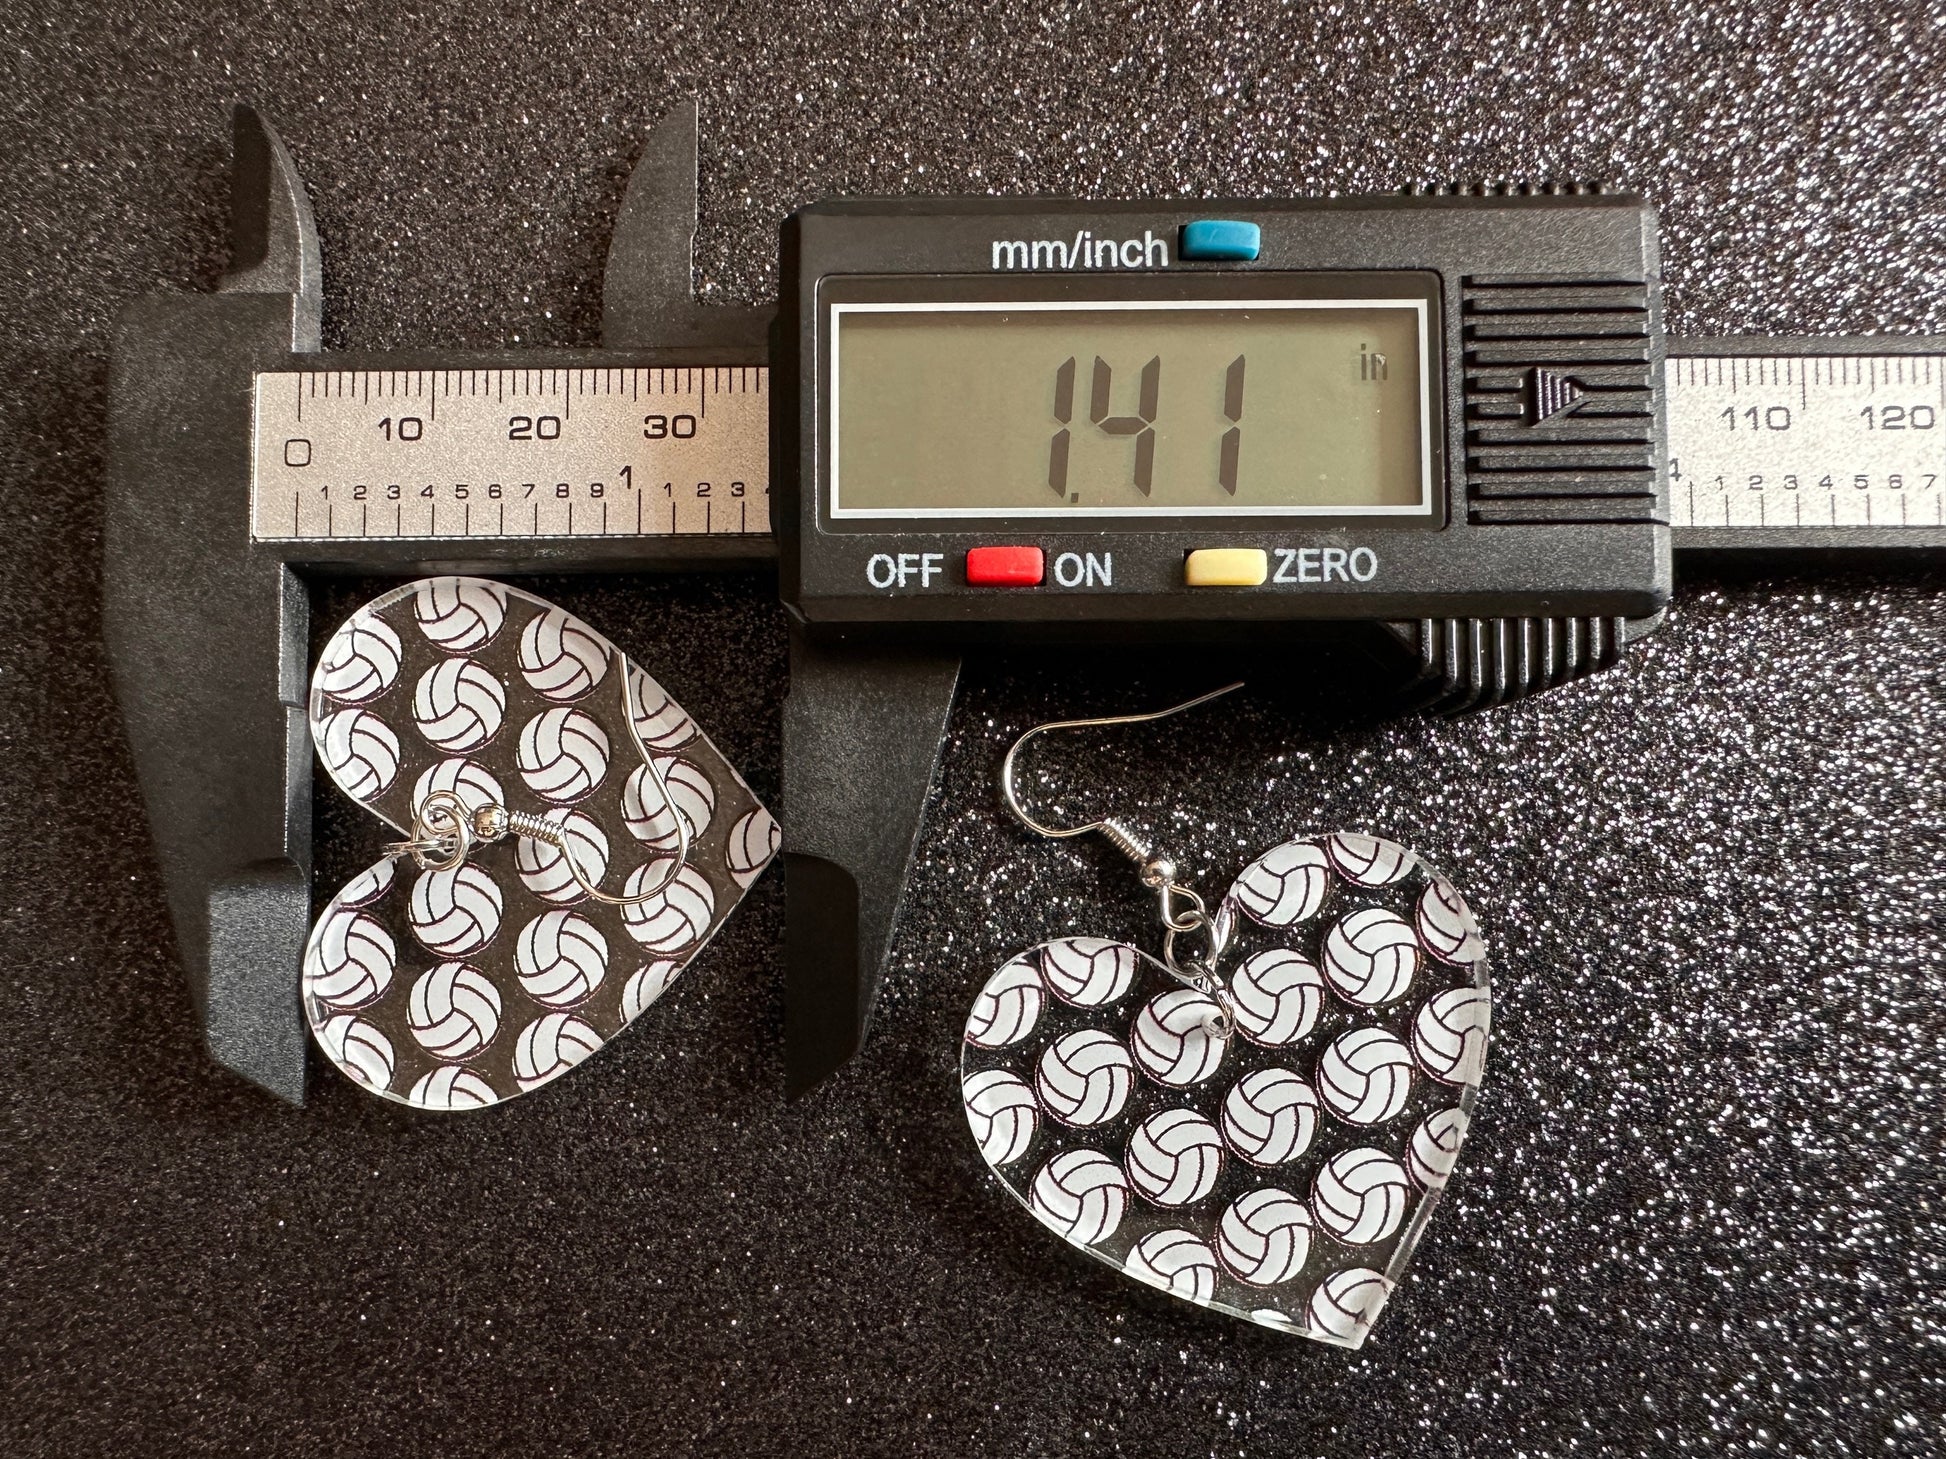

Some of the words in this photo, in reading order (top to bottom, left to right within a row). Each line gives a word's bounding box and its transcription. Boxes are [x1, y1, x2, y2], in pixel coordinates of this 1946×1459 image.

[991, 232, 1169, 271] mm/inch
[1359, 343, 1388, 381] in
[1721, 406, 1791, 430] 110
[1860, 405, 1935, 430] 120
[284, 439, 311, 467] 0
[378, 417, 422, 441] 10
[508, 416, 561, 440] 20
[643, 414, 697, 440] 30
[320, 486, 329, 499] 1
[353, 486, 367, 500] 2
[387, 485, 401, 500] 3
[421, 485, 434, 499] 4
[455, 485, 469, 499] 5
[488, 485, 502, 499] 6
[521, 485, 535, 499] 7
[556, 485, 569, 498] 8
[590, 484, 604, 498] 9
[619, 465, 632, 489] 1
[664, 483, 672, 497] 1
[697, 483, 711, 497] 2
[731, 482, 745, 496] 3
[1715, 475, 1723, 490] 1
[1750, 475, 1763, 490] 2
[1784, 475, 1798, 490] 3
[1819, 475, 1833, 490] 4
[1854, 475, 1869, 489] 5
[1889, 475, 1902, 489] 6
[1922, 475, 1937, 489] 7
[866, 553, 943, 589] OFF
[1054, 551, 1112, 588] ON
[1273, 546, 1377, 583] ZERO
